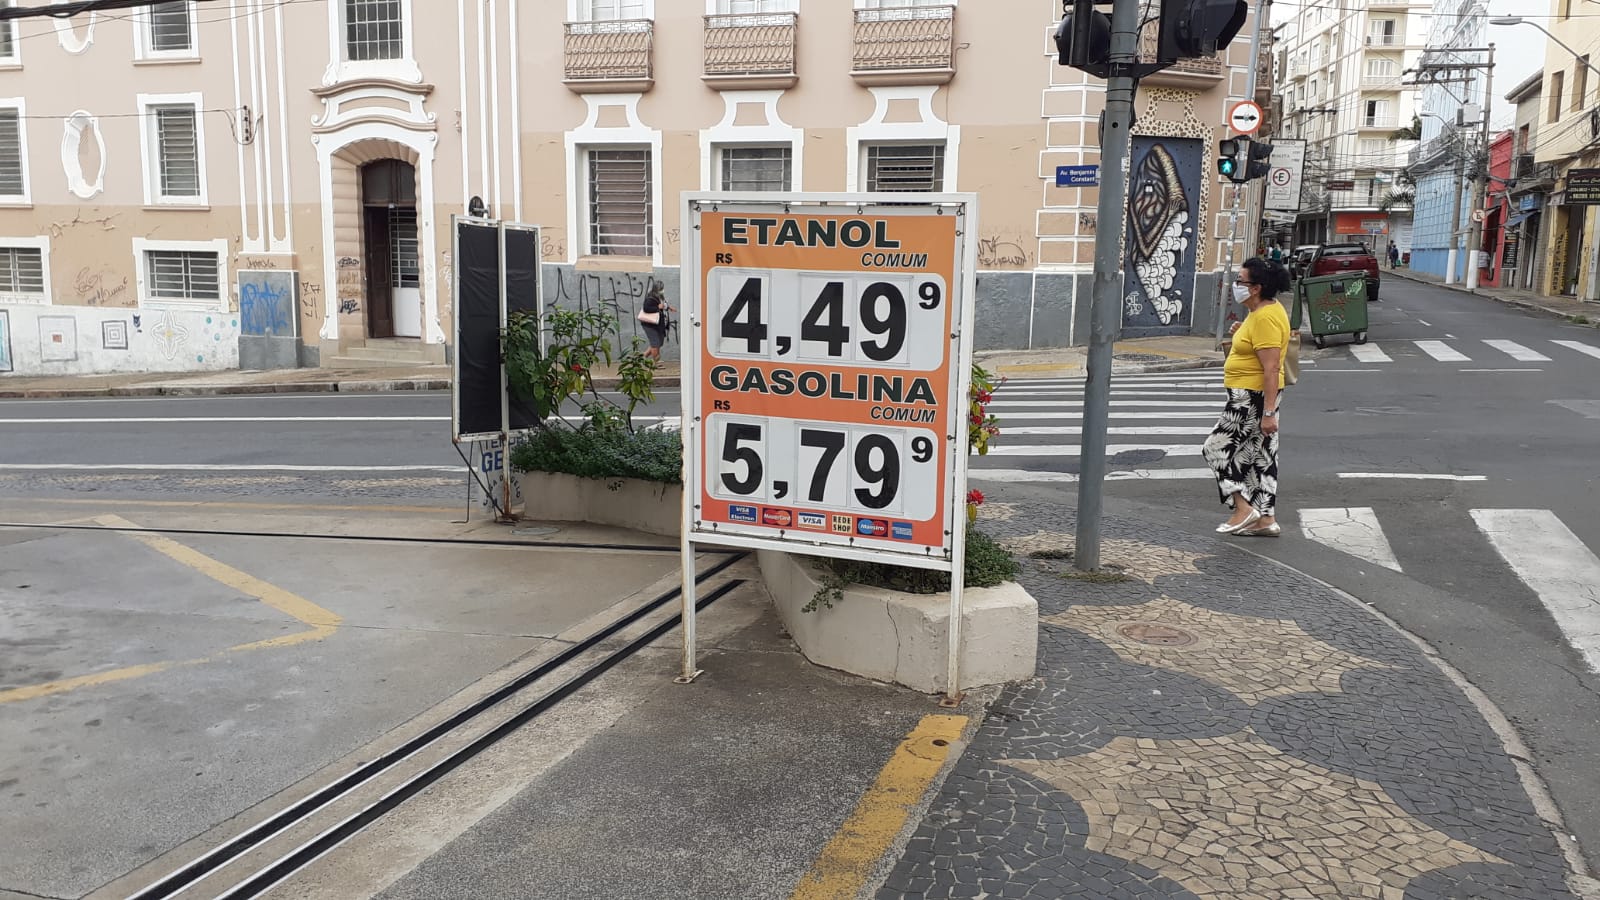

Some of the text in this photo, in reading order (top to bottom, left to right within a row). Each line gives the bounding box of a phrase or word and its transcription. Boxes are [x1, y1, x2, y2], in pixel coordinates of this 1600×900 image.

[723, 218, 901, 249] ETANOL
[715, 253, 733, 264] R$
[861, 253, 928, 268] COMUM
[710, 366, 938, 404] GASOLINA
[713, 400, 731, 411] R$
[870, 406, 936, 423] COMUM
[730, 514, 755, 522] Electron
[764, 513, 792, 523] MasterCard
[802, 516, 823, 525] VISA
[833, 515, 852, 524] REDE
[832, 524, 852, 532] SHOP
[860, 522, 885, 532] Maestro
